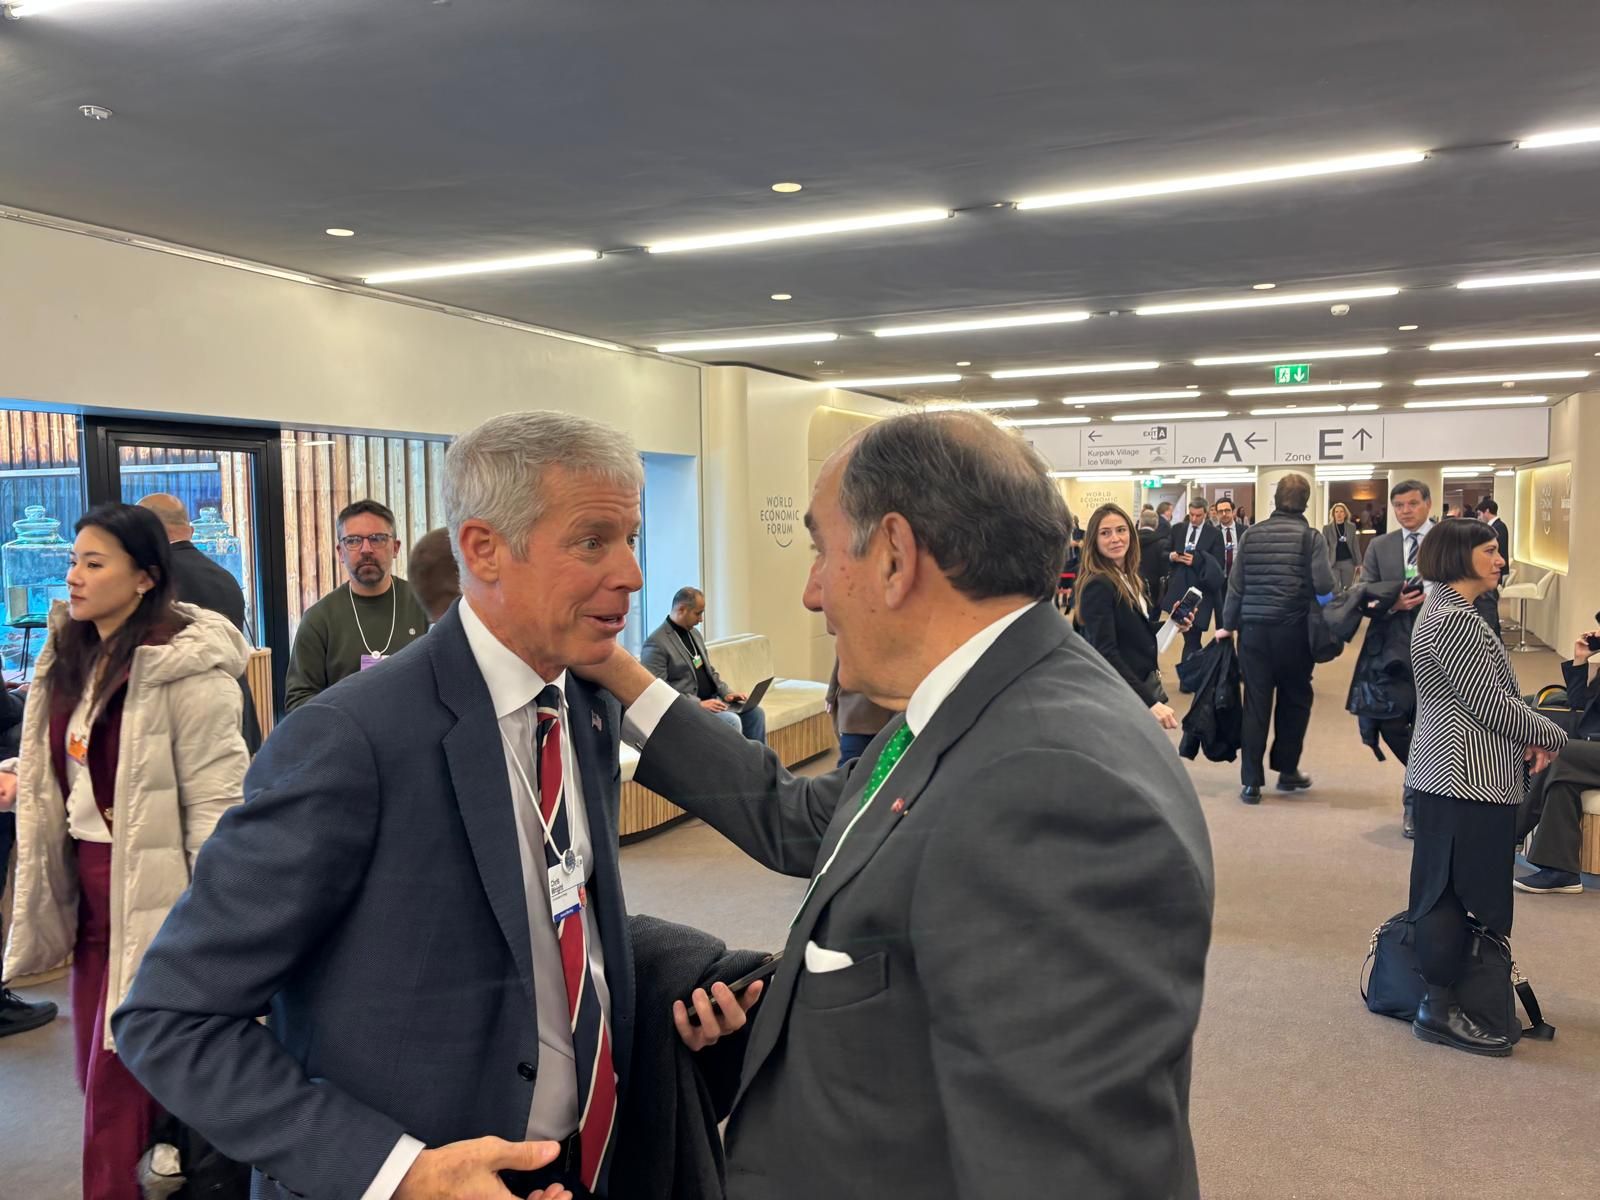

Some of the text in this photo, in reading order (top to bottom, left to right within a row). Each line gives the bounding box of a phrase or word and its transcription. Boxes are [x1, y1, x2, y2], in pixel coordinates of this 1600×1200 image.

[1182, 432, 1242, 464] Zone A
[1285, 429, 1344, 462] Zone E
[1088, 449, 1115, 457] Kurpark
[767, 496, 793, 508] WORLD
[760, 510, 800, 521] ECONOMIC
[767, 523, 793, 534] FORUM
